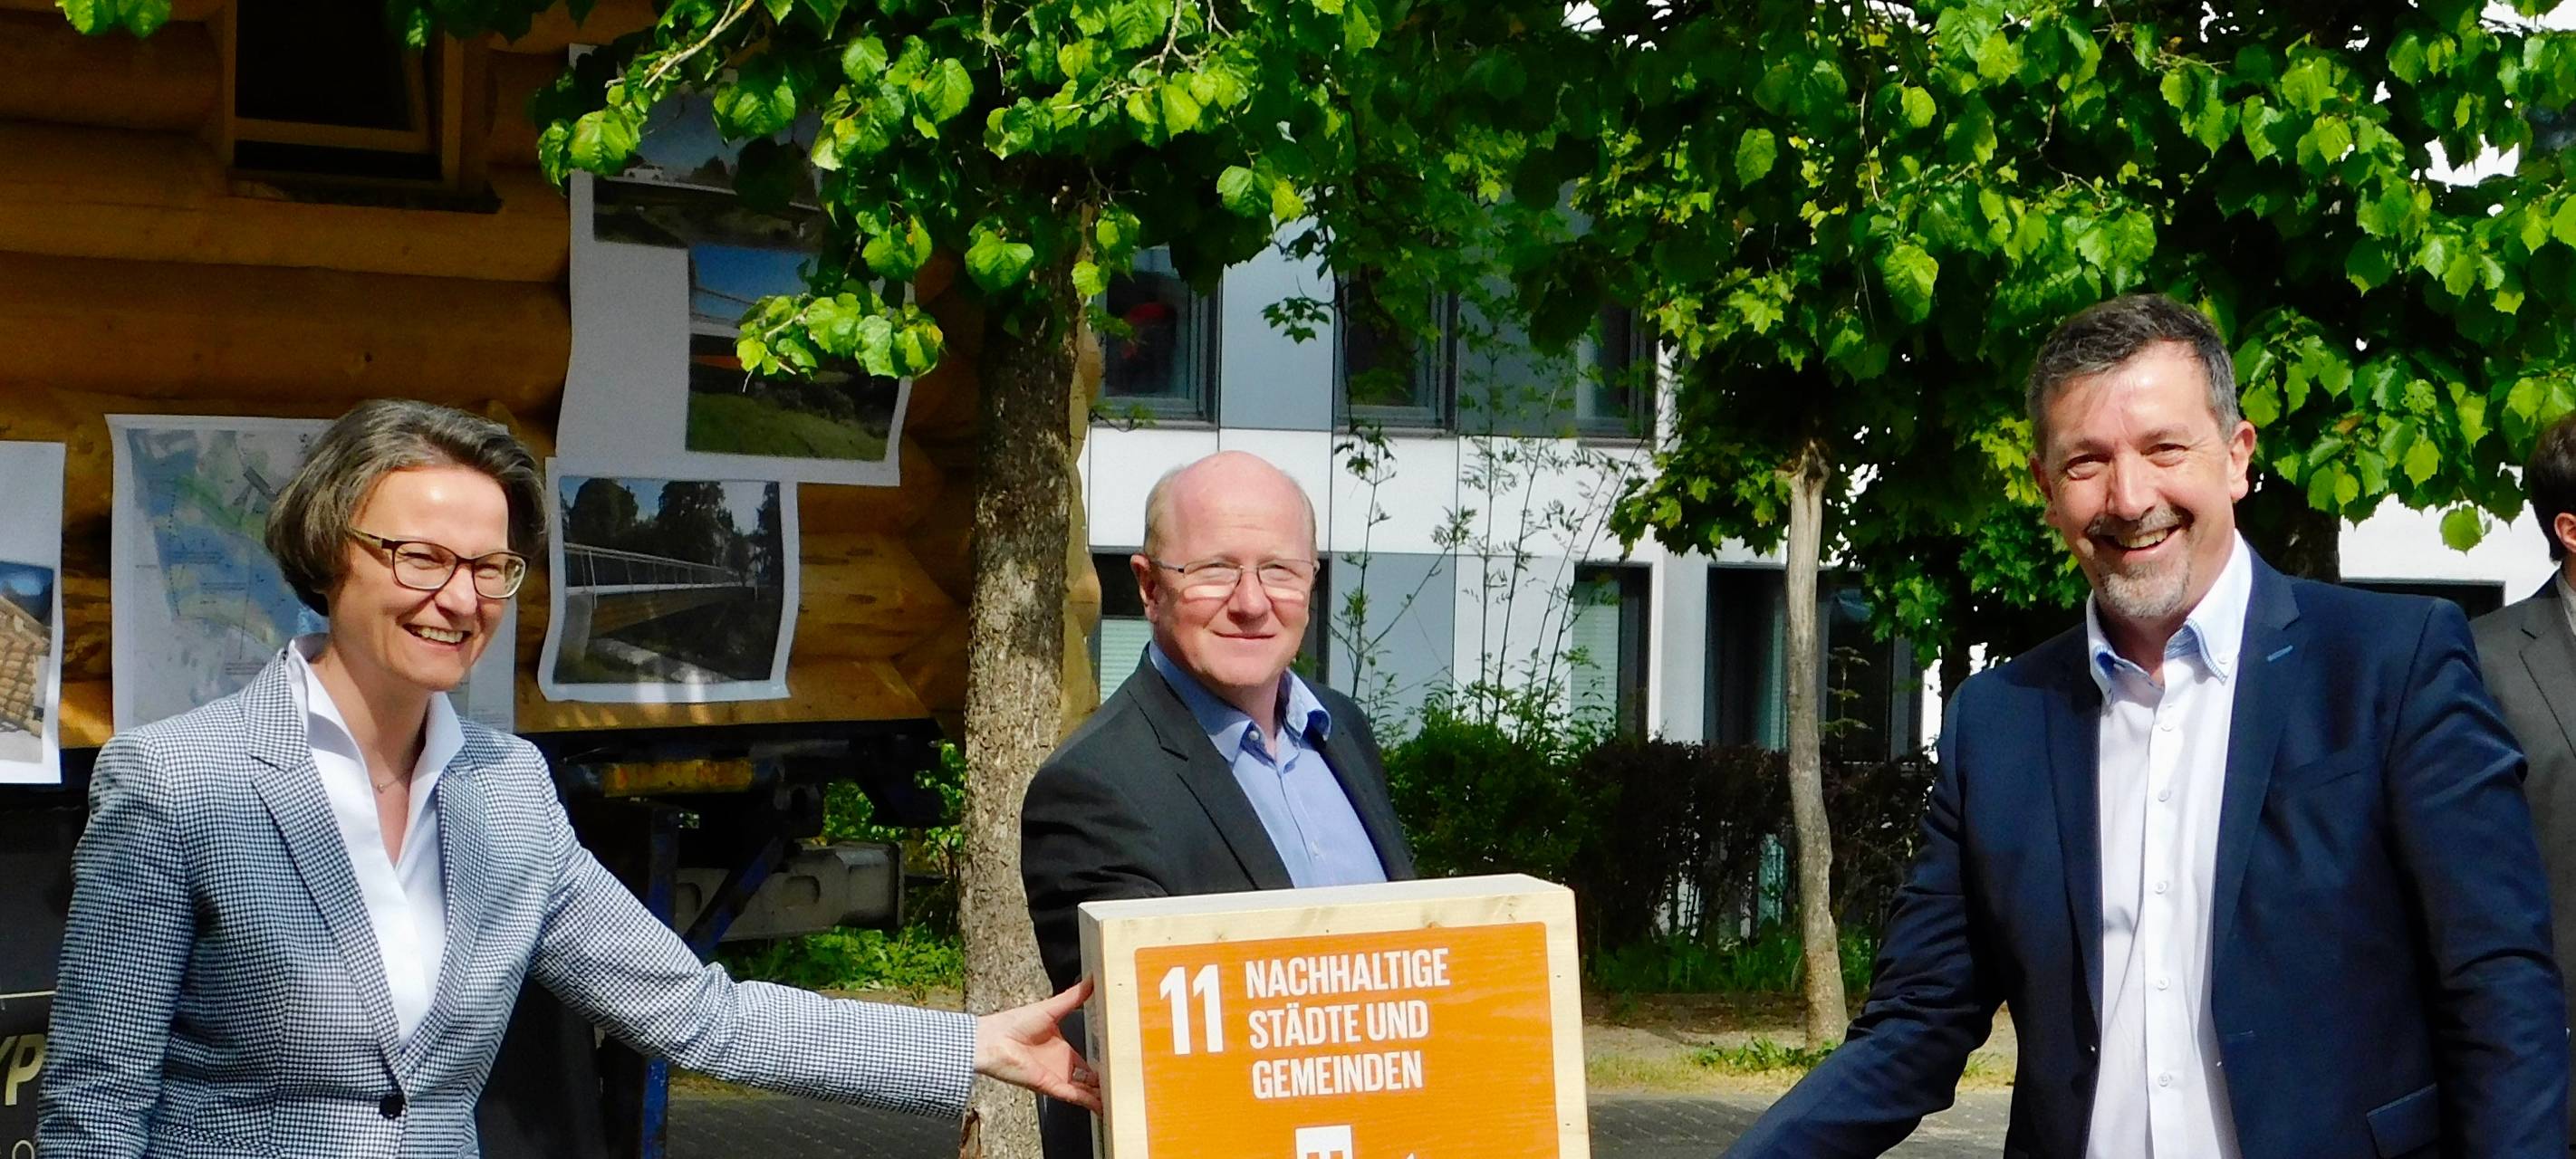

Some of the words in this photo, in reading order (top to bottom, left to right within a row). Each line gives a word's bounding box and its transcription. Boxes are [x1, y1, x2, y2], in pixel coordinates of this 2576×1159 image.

[1245, 947, 1451, 1000] NACHHALTIGE
[1159, 963, 1225, 1056] 11
[1248, 1001, 1362, 1050] STÄDTE
[1365, 999, 1429, 1042] UND
[1252, 1049, 1424, 1099] GEMEINDEN
